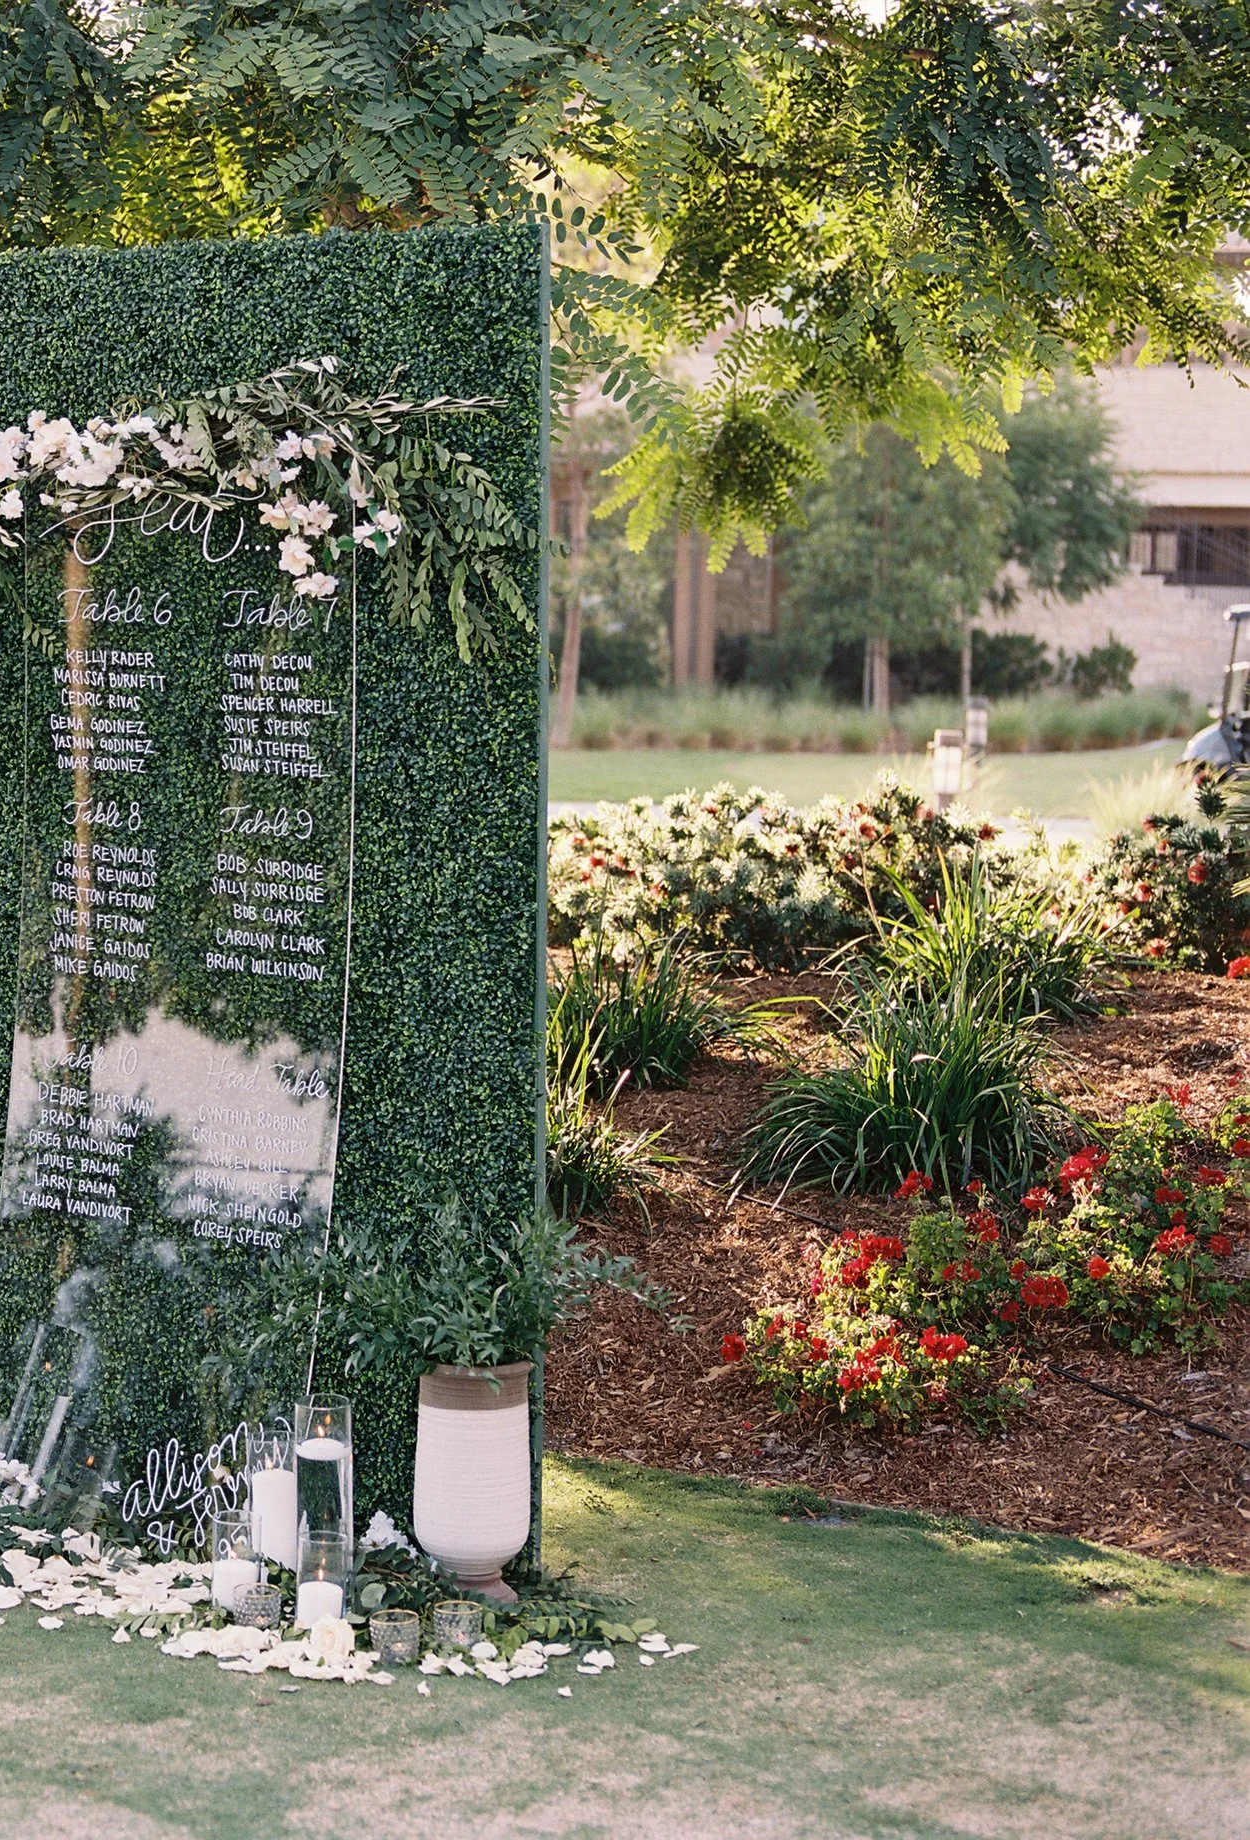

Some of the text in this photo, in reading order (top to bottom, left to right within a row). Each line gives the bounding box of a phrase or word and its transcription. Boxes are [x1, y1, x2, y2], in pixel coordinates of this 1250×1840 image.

[57, 586, 172, 625] Table 6
[222, 590, 338, 633] Table 7
[66, 649, 155, 671] KELLY RADER
[224, 654, 264, 671] CATHY
[54, 668, 166, 692] MARISSA BURNETT
[230, 674, 254, 689] TIM
[61, 688, 141, 711] CEDRIC RIVAS
[220, 694, 338, 714] SPENCER HARRELL
[51, 714, 146, 734] GEMA GODINEZ
[224, 715, 310, 736] SUSIE SPEIRS
[52, 734, 155, 754] YASMIN GODINEZ
[229, 738, 318, 760] JIM STEIFFEL
[58, 754, 146, 773] OMAR GODINEZ
[222, 754, 333, 778] SUSAN STEIFFEL
[63, 798, 141, 830] Table 8
[220, 805, 312, 839] Table 9
[63, 841, 157, 867] ROE REYNOLDS
[217, 854, 324, 881] BOB SURRIDGE
[56, 861, 158, 888] CRAIG REYNOLDS
[52, 882, 156, 910] PRESTON FETROW
[210, 877, 324, 902] SALLY SURRIDGE
[52, 907, 145, 933] SHERI FETROW
[234, 904, 304, 926] BOB CLARK
[50, 931, 151, 958] JANICE GAIDOS
[217, 928, 325, 955] CAROLYN CLARK
[54, 955, 138, 982] MIKE GAIDOS
[206, 952, 324, 981] BRIAN WILKINSON
[45, 1038, 137, 1075] Table 10
[266, 1063, 329, 1098] Table
[39, 1082, 154, 1116] DEBBIE HARTMAN
[41, 1109, 139, 1139] BRAD HARTMAN
[199, 1104, 307, 1132] CYNTHIA ROBBINS
[29, 1129, 134, 1159] GREG VANDIVORT
[192, 1126, 308, 1159] CRISTINA BARNEY
[37, 1152, 120, 1176] LOUISE BALMA
[206, 1149, 288, 1174] ASHLEY GILL
[35, 1172, 116, 1199] LARRY BALMA
[195, 1170, 299, 1203] BRYAN UECKER
[22, 1190, 132, 1225] LAURA VANDIVORT
[187, 1194, 301, 1227] NICK SHEINGOLD
[193, 1220, 282, 1249] COREY SPEIRS
